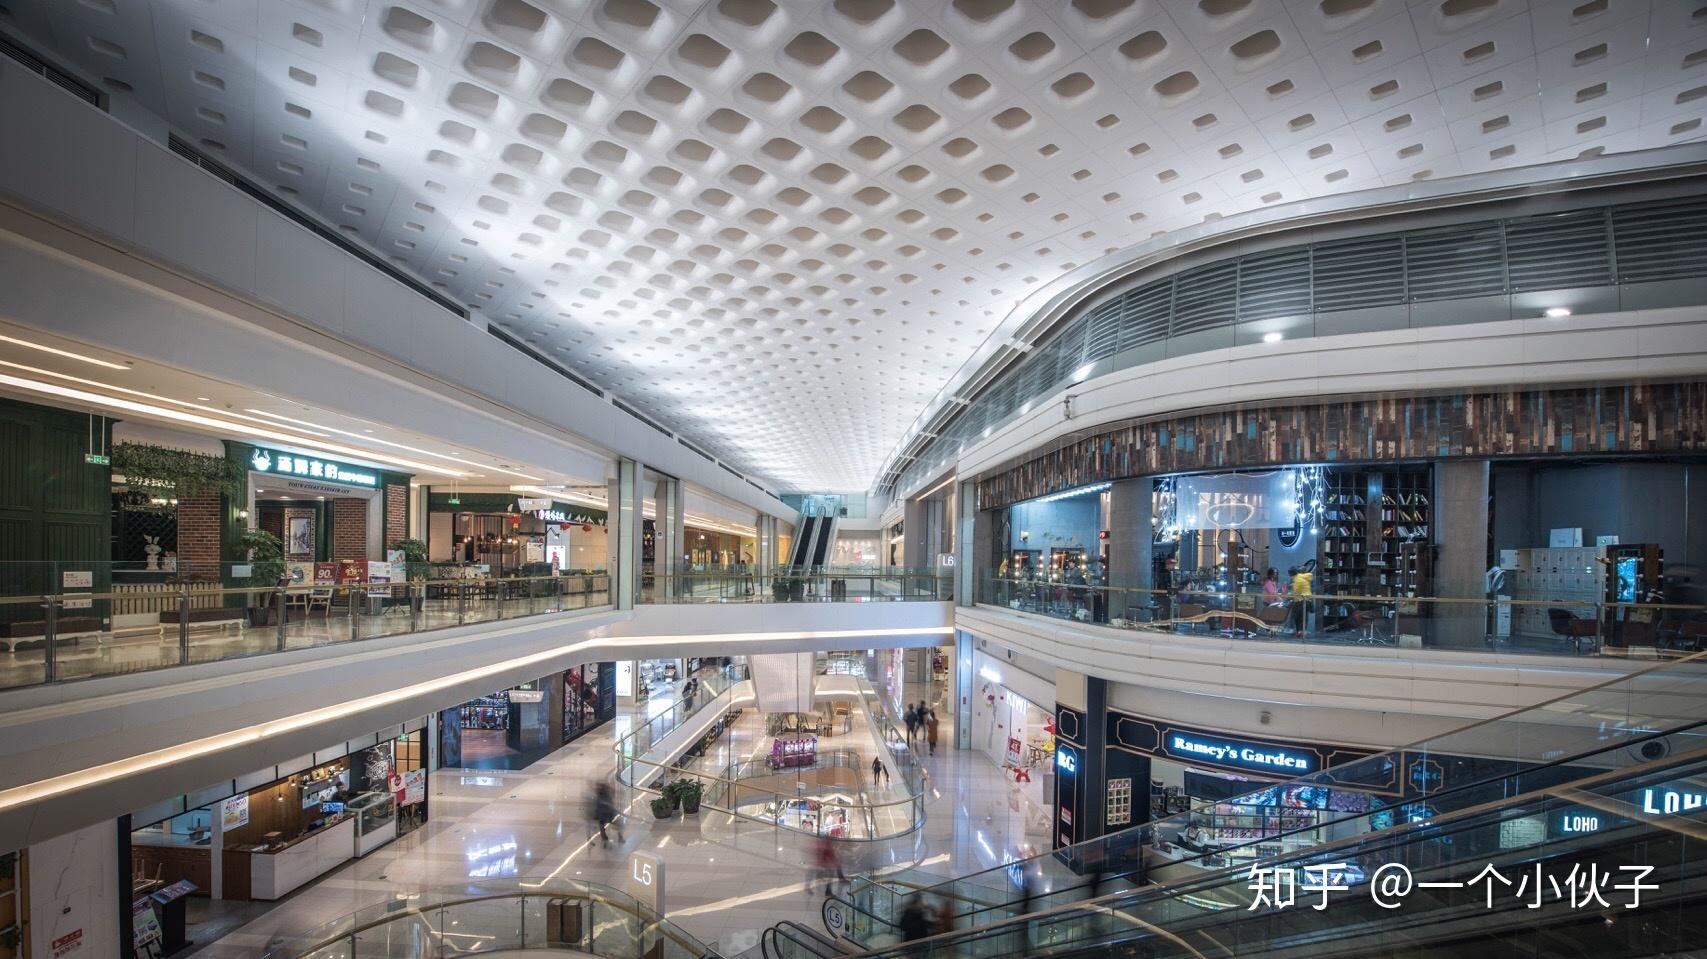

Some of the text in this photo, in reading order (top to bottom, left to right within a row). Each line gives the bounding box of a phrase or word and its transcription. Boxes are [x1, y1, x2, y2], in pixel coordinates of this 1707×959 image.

[943, 555, 954, 567] L6
[1174, 737, 1308, 769] Ramey's Garden
[1643, 789, 1707, 815] LOH
[1563, 816, 1598, 832] LOHO
[633, 858, 651, 886] L5
[829, 910, 840, 924] L5
